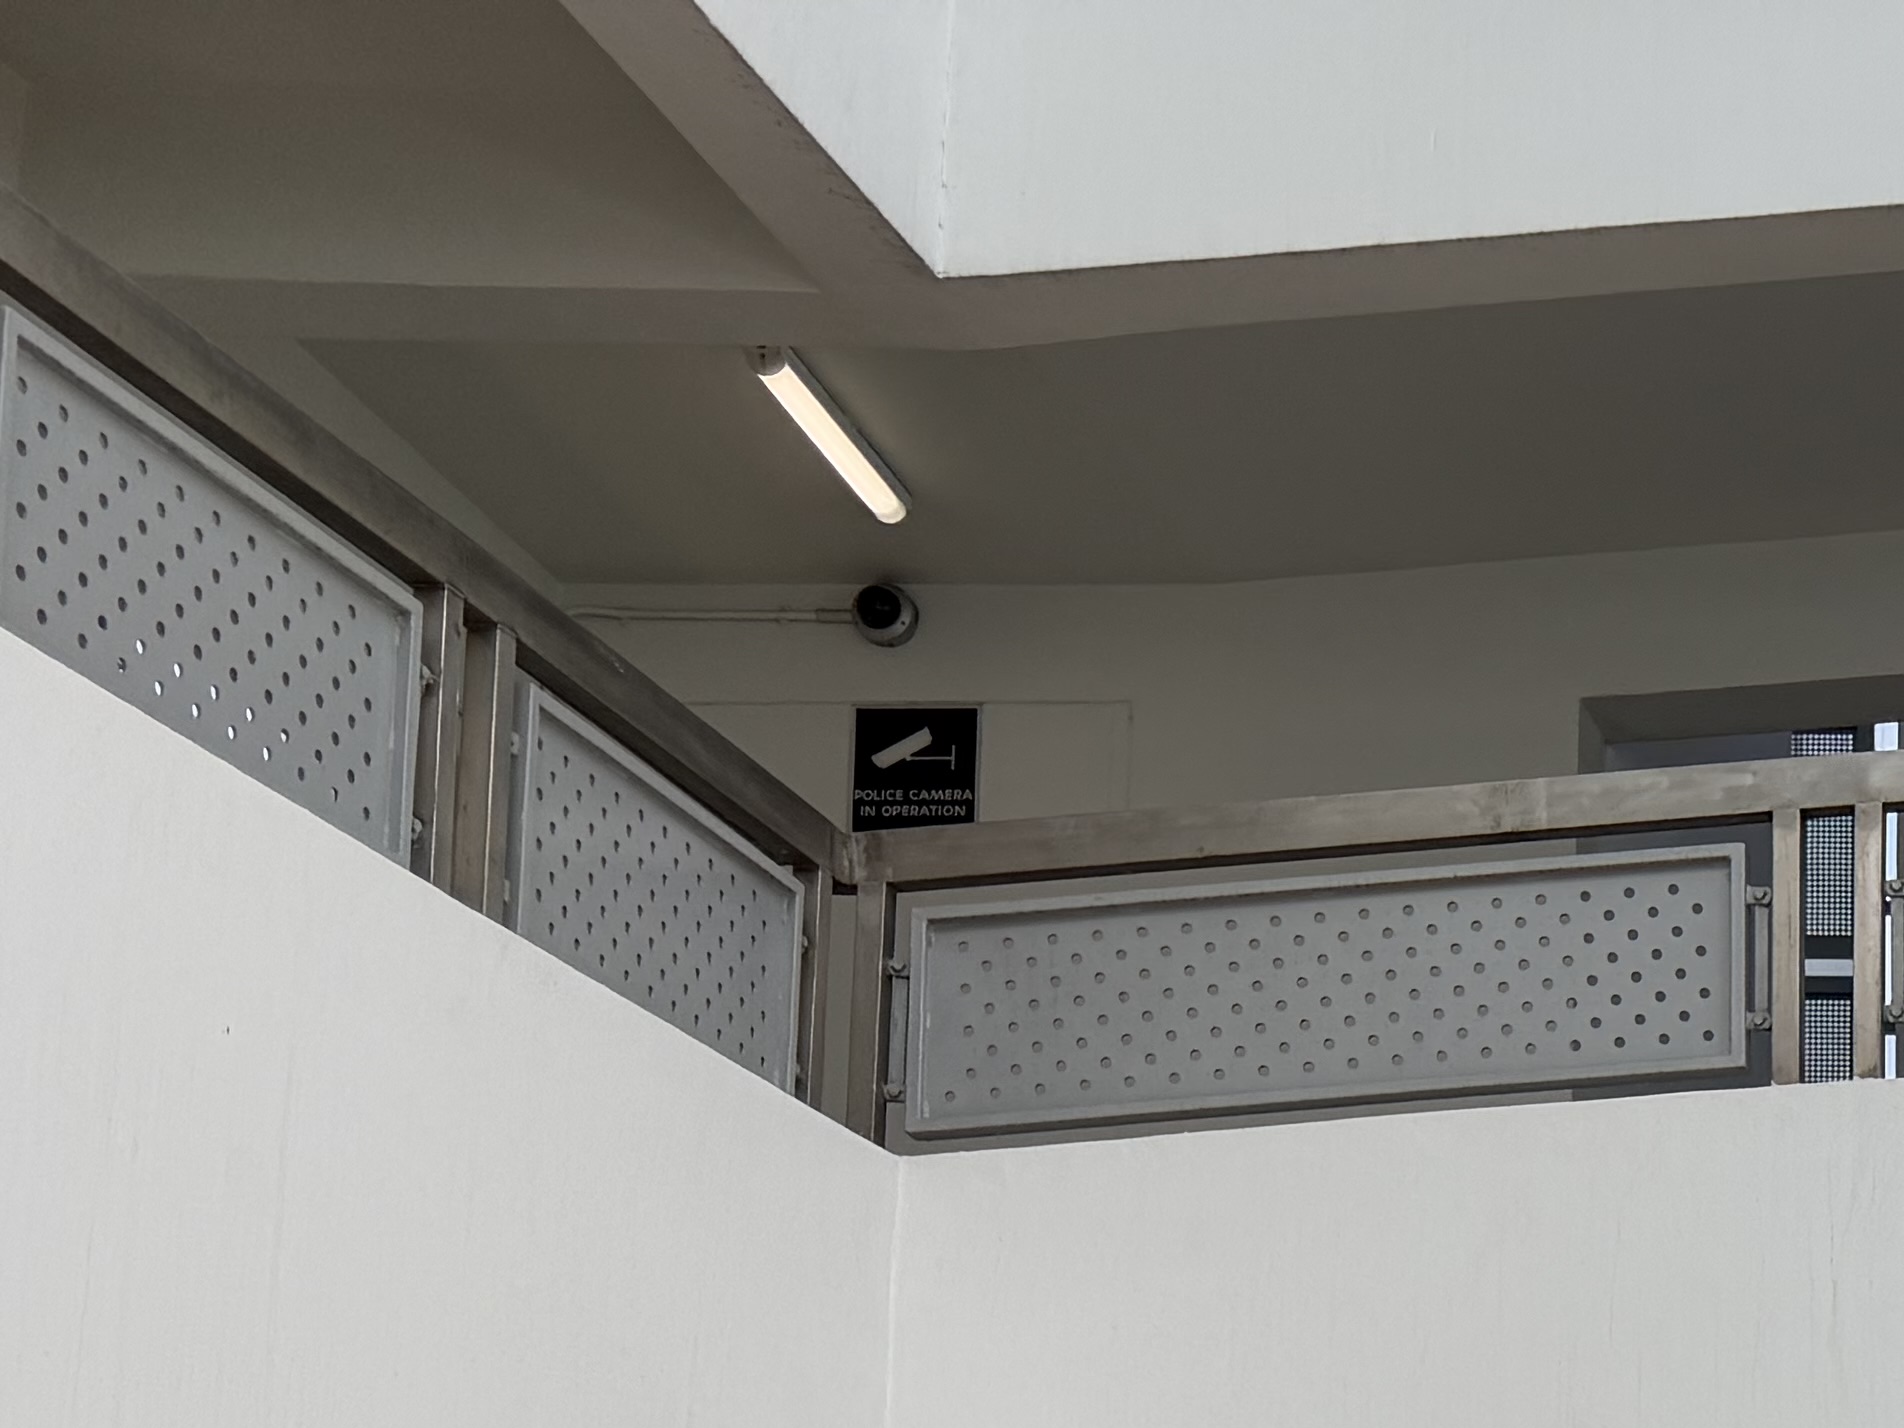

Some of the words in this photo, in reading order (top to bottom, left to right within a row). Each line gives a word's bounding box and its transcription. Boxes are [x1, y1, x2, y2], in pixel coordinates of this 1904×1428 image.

[854, 789, 904, 801] POLICE
[909, 789, 973, 801] CAMERA
[860, 805, 876, 817] IN
[881, 805, 966, 817] OPERATION
